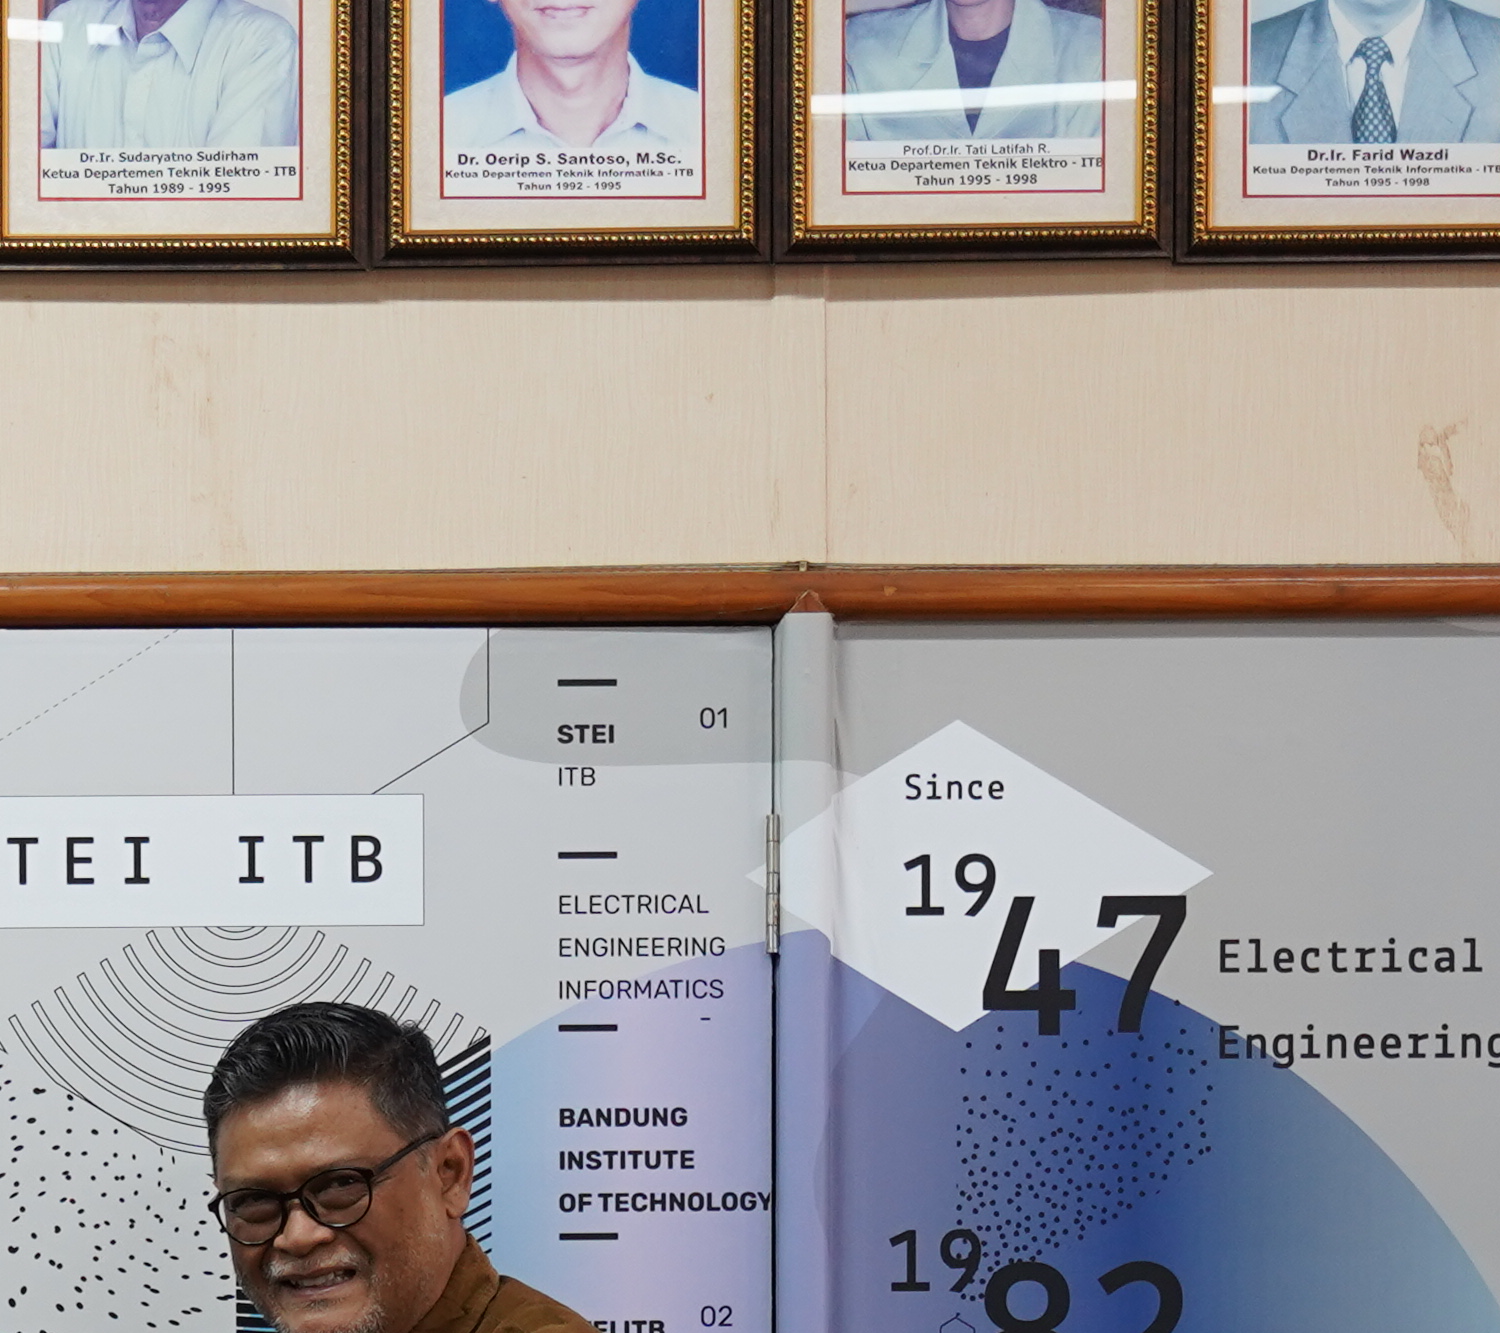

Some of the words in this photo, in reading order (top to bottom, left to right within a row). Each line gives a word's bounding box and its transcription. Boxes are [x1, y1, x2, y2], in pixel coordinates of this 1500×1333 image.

[79, 152, 114, 164] Dr.Ir.
[118, 151, 193, 166] Sudaryatno
[196, 150, 259, 162] Sudirham
[457, 153, 479, 166] Dr.
[485, 153, 530, 168] Oerip
[535, 152, 551, 166] S.
[557, 152, 630, 167] Santoso,
[636, 151, 682, 165] M.Sc.
[903, 144, 961, 156] Prof.Dr.Ir.
[965, 144, 987, 156] Tati
[991, 143, 1034, 155] Latifah
[1037, 142, 1050, 154] R.
[1307, 149, 1346, 162] Dr.Ir.
[1352, 148, 1394, 162] Farid
[1399, 148, 1449, 161] Wazdi
[699, 706, 728, 730] 01
[557, 723, 615, 745] STEI
[558, 766, 596, 787] ITB
[904, 771, 1006, 802] Since
[237, 833, 384, 885] ITB
[558, 893, 710, 915] ELECTRICAL
[558, 936, 726, 958] ENGINEERING
[1218, 936, 1484, 975] Electrical
[559, 978, 725, 1000] INFORMATICS
[559, 1106, 688, 1128] BANDUNG
[559, 1149, 695, 1171] INSTITUTE
[558, 1192, 593, 1213] OF
[597, 1191, 773, 1214] TECHNOLOGY
[700, 1305, 733, 1328] 02
